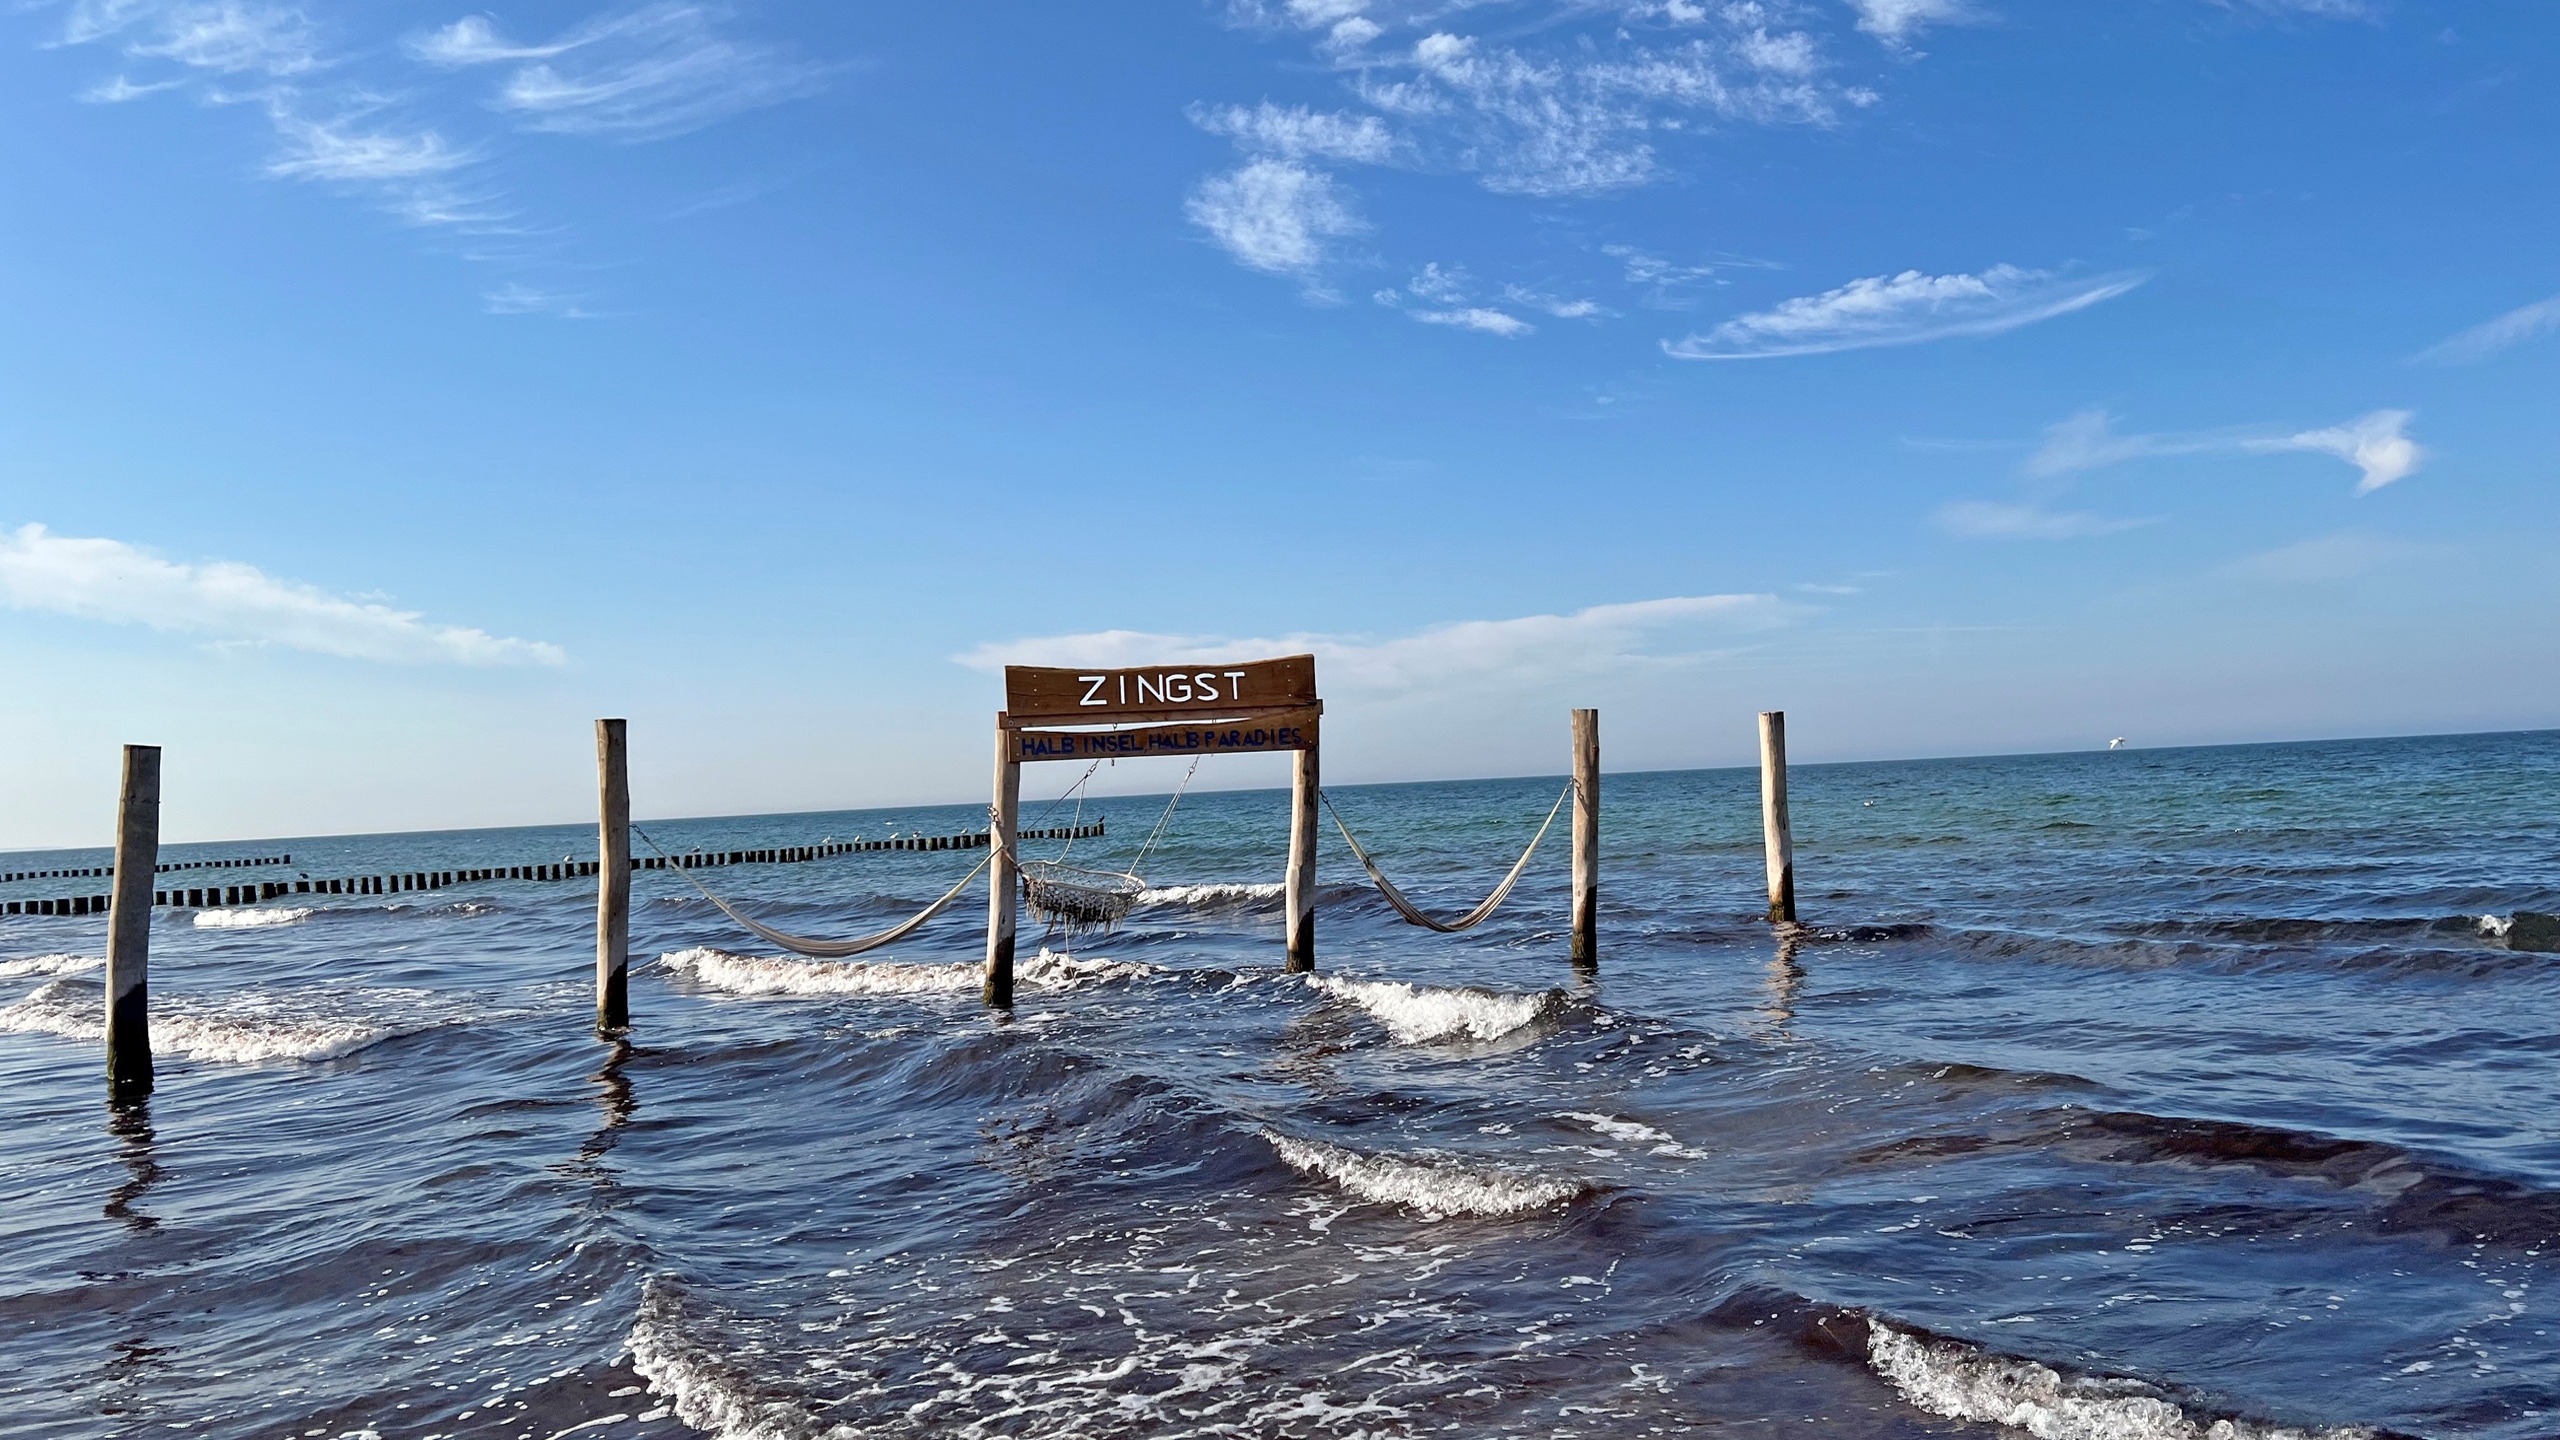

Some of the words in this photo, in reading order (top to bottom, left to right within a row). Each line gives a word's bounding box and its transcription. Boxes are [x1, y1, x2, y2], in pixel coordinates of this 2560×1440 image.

[1078, 671, 1246, 706] ZINGST
[1021, 736, 1076, 756] HALB
[1149, 731, 1200, 750] HALB
